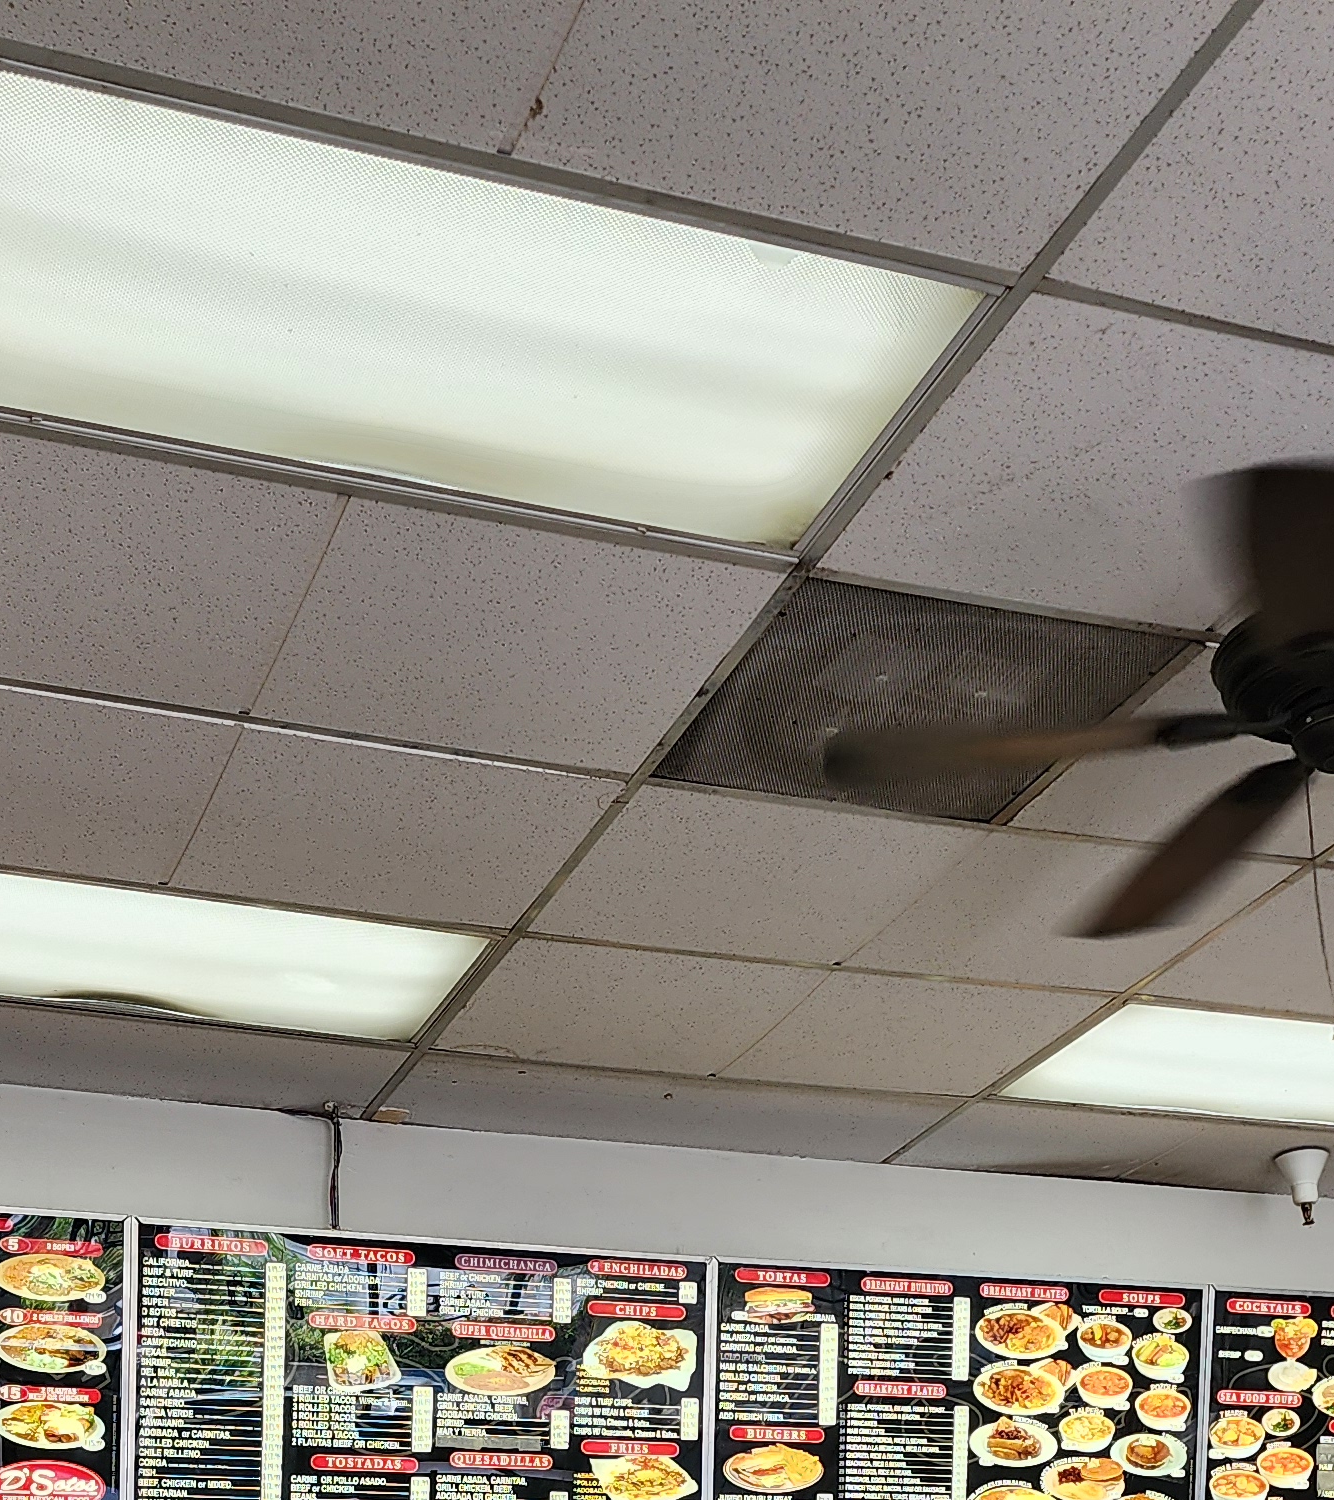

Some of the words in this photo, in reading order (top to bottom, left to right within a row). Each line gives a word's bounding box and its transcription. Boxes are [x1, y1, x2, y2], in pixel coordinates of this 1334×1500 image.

[8, 1238, 19, 1251] 5
[170, 1237, 250, 1252] BURRITOS
[315, 1247, 354, 1260] SOFT
[358, 1249, 406, 1263] TACOS
[143, 1257, 190, 1268] CALIFORNIA
[461, 1256, 552, 1272] CHIMICHANGA
[603, 1262, 684, 1277] ENCHILADAS
[757, 1271, 807, 1283] TORTAS
[866, 1279, 909, 1292] BREAKFAST
[910, 1281, 949, 1294] BURRITOS
[983, 1286, 1032, 1297] BREAKFAST
[1034, 1288, 1066, 1299] PLATES
[142, 1297, 169, 1307] SUPER
[1122, 1293, 1161, 1304] SOUPS
[616, 1305, 657, 1317] CHIPS
[1235, 1301, 1302, 1314] COCKTAILS
[2, 1310, 24, 1322] 10
[141, 1318, 160, 1327] HOT
[315, 1315, 356, 1328] HARD
[362, 1317, 410, 1331] TACOS
[455, 1324, 487, 1338] SUPER
[489, 1325, 551, 1340] QUESADILLA
[0, 1386, 21, 1400] 15
[858, 1383, 907, 1395] BREAKFAST
[909, 1384, 944, 1396] PLATES
[1220, 1393, 1237, 1402] SEA
[1240, 1393, 1266, 1404] FOOD
[1268, 1394, 1299, 1405] SOUPS
[746, 1429, 807, 1440] BURGERS
[611, 1443, 649, 1454] FRIES
[325, 1457, 403, 1469] TOSTADAS
[454, 1454, 549, 1467] QUESADILLAS
[138, 1489, 187, 1498] VEGETARIAN
